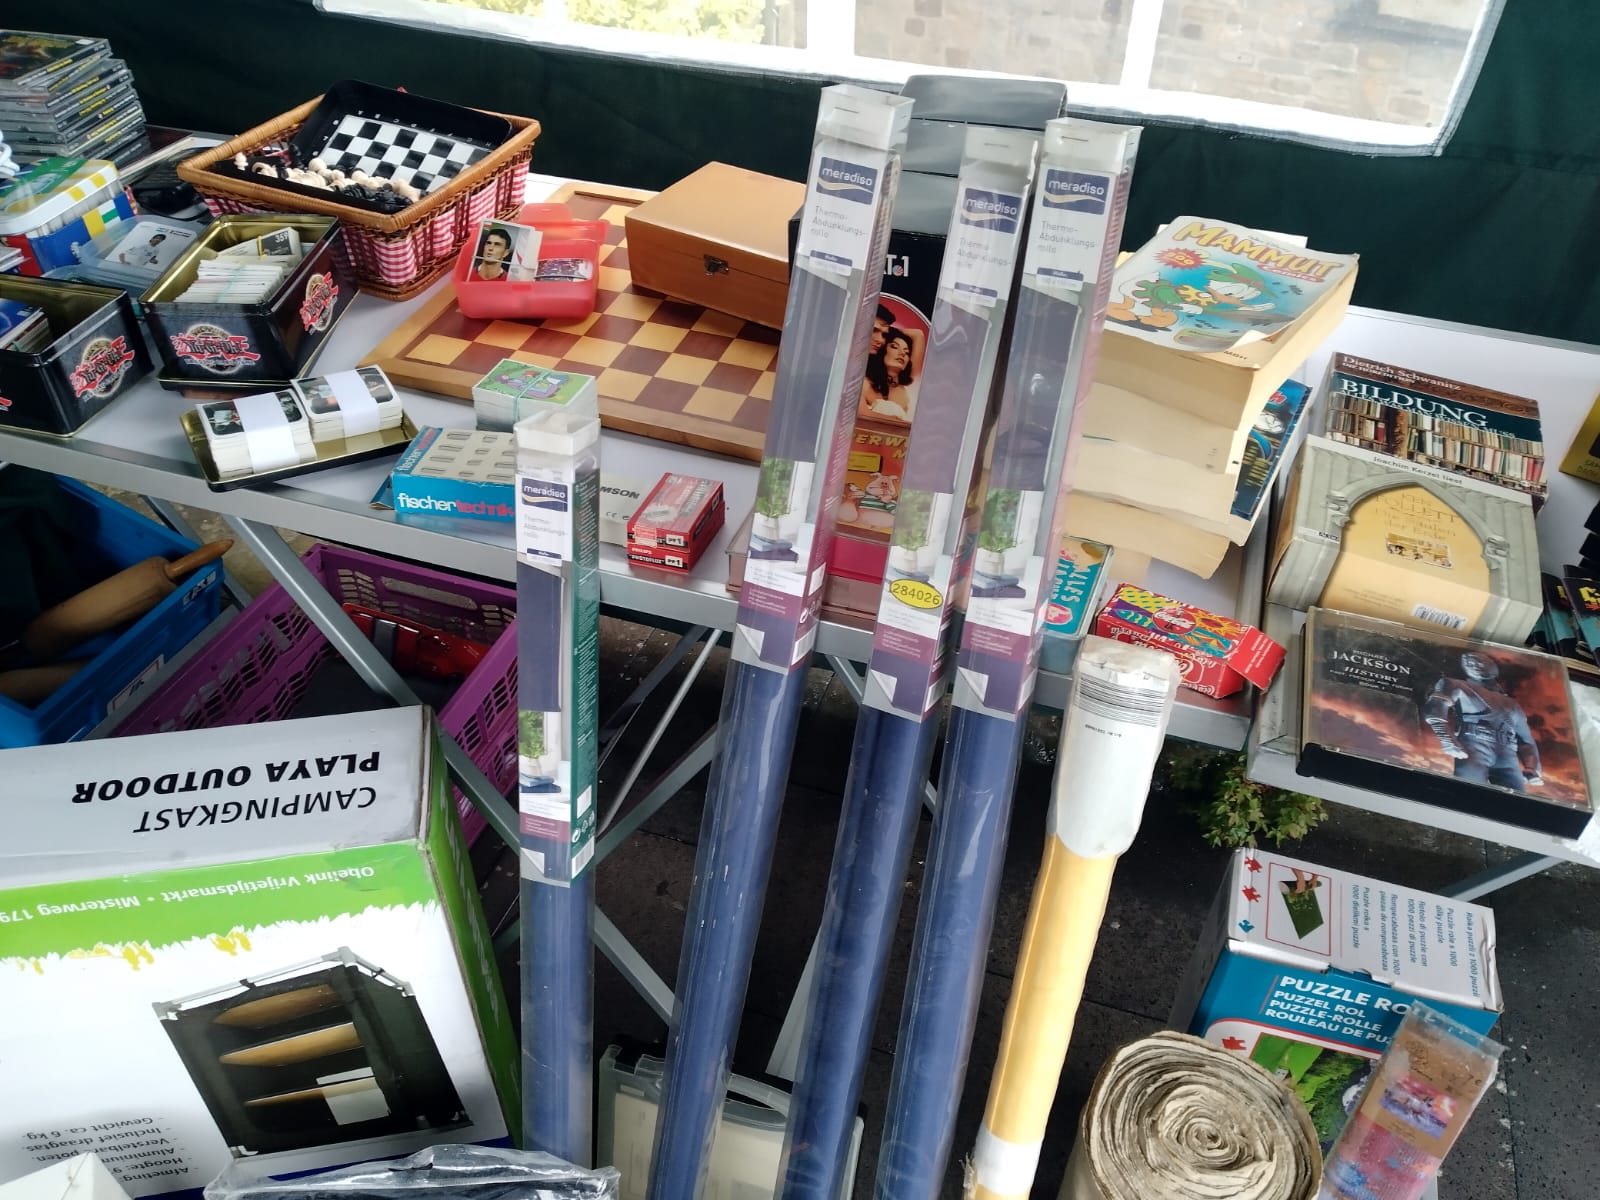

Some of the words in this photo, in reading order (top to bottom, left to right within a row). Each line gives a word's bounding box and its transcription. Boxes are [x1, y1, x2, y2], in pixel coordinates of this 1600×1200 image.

[822, 166, 873, 186] meradiso
[1049, 179, 1104, 195] meradiso
[966, 198, 1017, 215] meradiso
[1173, 222, 1345, 278] MAMMUT
[1343, 356, 1394, 374] Dietrich
[1398, 369, 1461, 391] Schwanitz
[1341, 379, 1488, 427] BILDUNG
[1374, 456, 1409, 470] Joachim
[1412, 466, 1439, 479] Kerzel
[523, 484, 566, 499] meradiso
[600, 486, 640, 499] MSON
[892, 583, 940, 605] 284026
[1331, 650, 1411, 675] JACKSON
[1345, 666, 1398, 682] HISTORY
[266, 751, 381, 783] PLAYA
[71, 764, 251, 804] OUTDOOR
[133, 785, 377, 833] CAMPINGKAST
[304, 865, 375, 886] Obelink
[160, 876, 300, 903] Vrijetijdsmarkt
[37, 894, 140, 916] Misterweg
[1280, 976, 1370, 1006] PUZZLE
[1274, 990, 1332, 1011] PUZZEL
[1335, 1004, 1366, 1018] ROL
[1265, 1009, 1339, 1032] ROULEAU
[1342, 1025, 1362, 1039] DE
[1270, 1000, 1382, 1032] PUZZLE-ROLLE
[50, 1130, 60, 1138] 6
[65, 1127, 87, 1135] ca.
[91, 1117, 153, 1132] Gewicht
[98, 1127, 161, 1143] Inclusief
[22, 1132, 46, 1142] kg.
[87, 1138, 169, 1153] Verstelbar
[125, 1157, 183, 1171] Hoogte:
